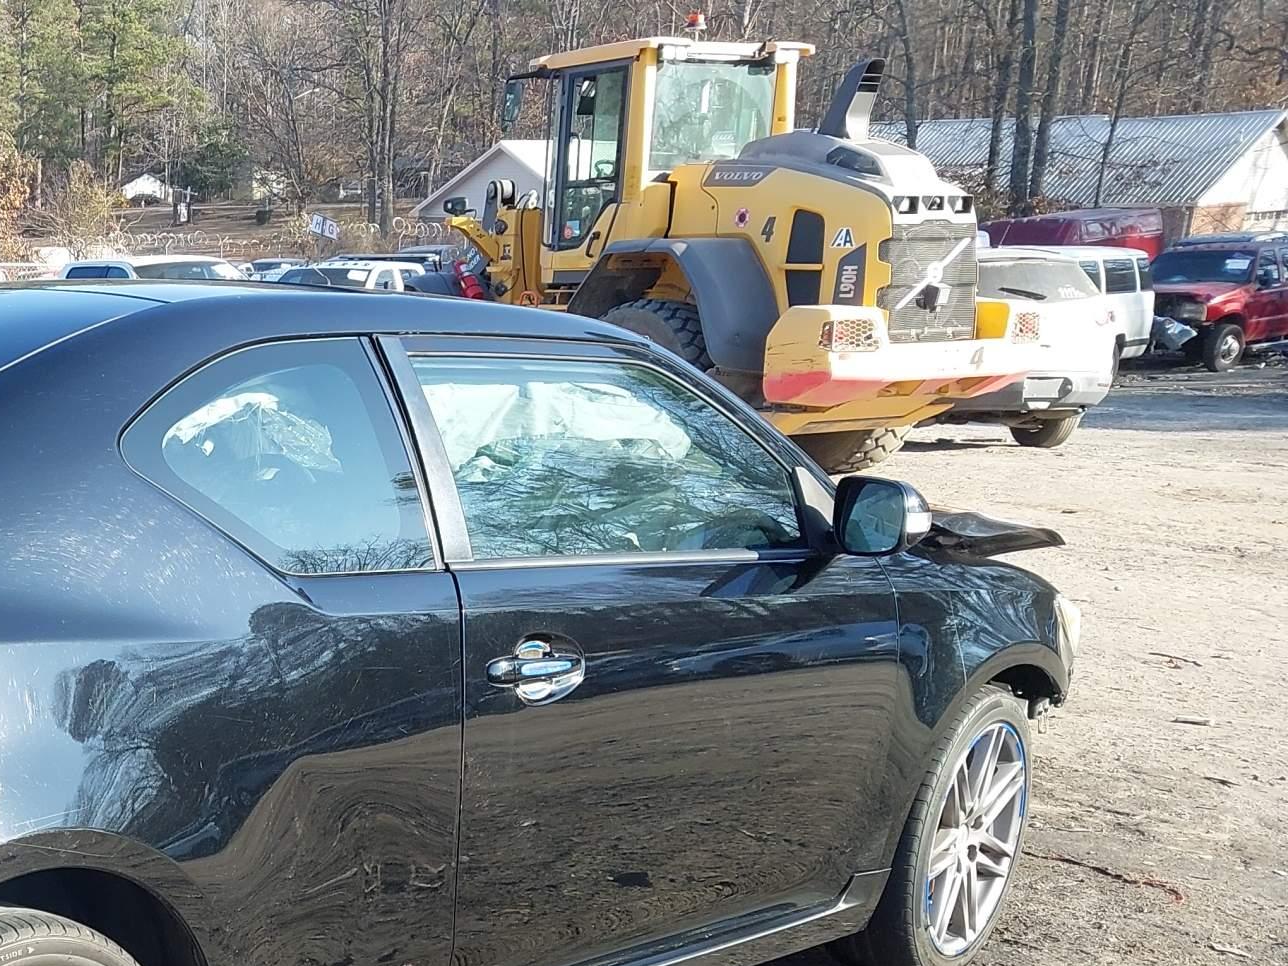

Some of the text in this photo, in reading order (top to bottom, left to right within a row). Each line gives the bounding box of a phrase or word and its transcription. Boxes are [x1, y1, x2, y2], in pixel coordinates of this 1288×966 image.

[714, 171, 764, 181] VOLVO
[314, 217, 335, 235] H G
[760, 216, 777, 242] 4
[838, 265, 859, 298] L90H
[969, 346, 984, 371] 4
